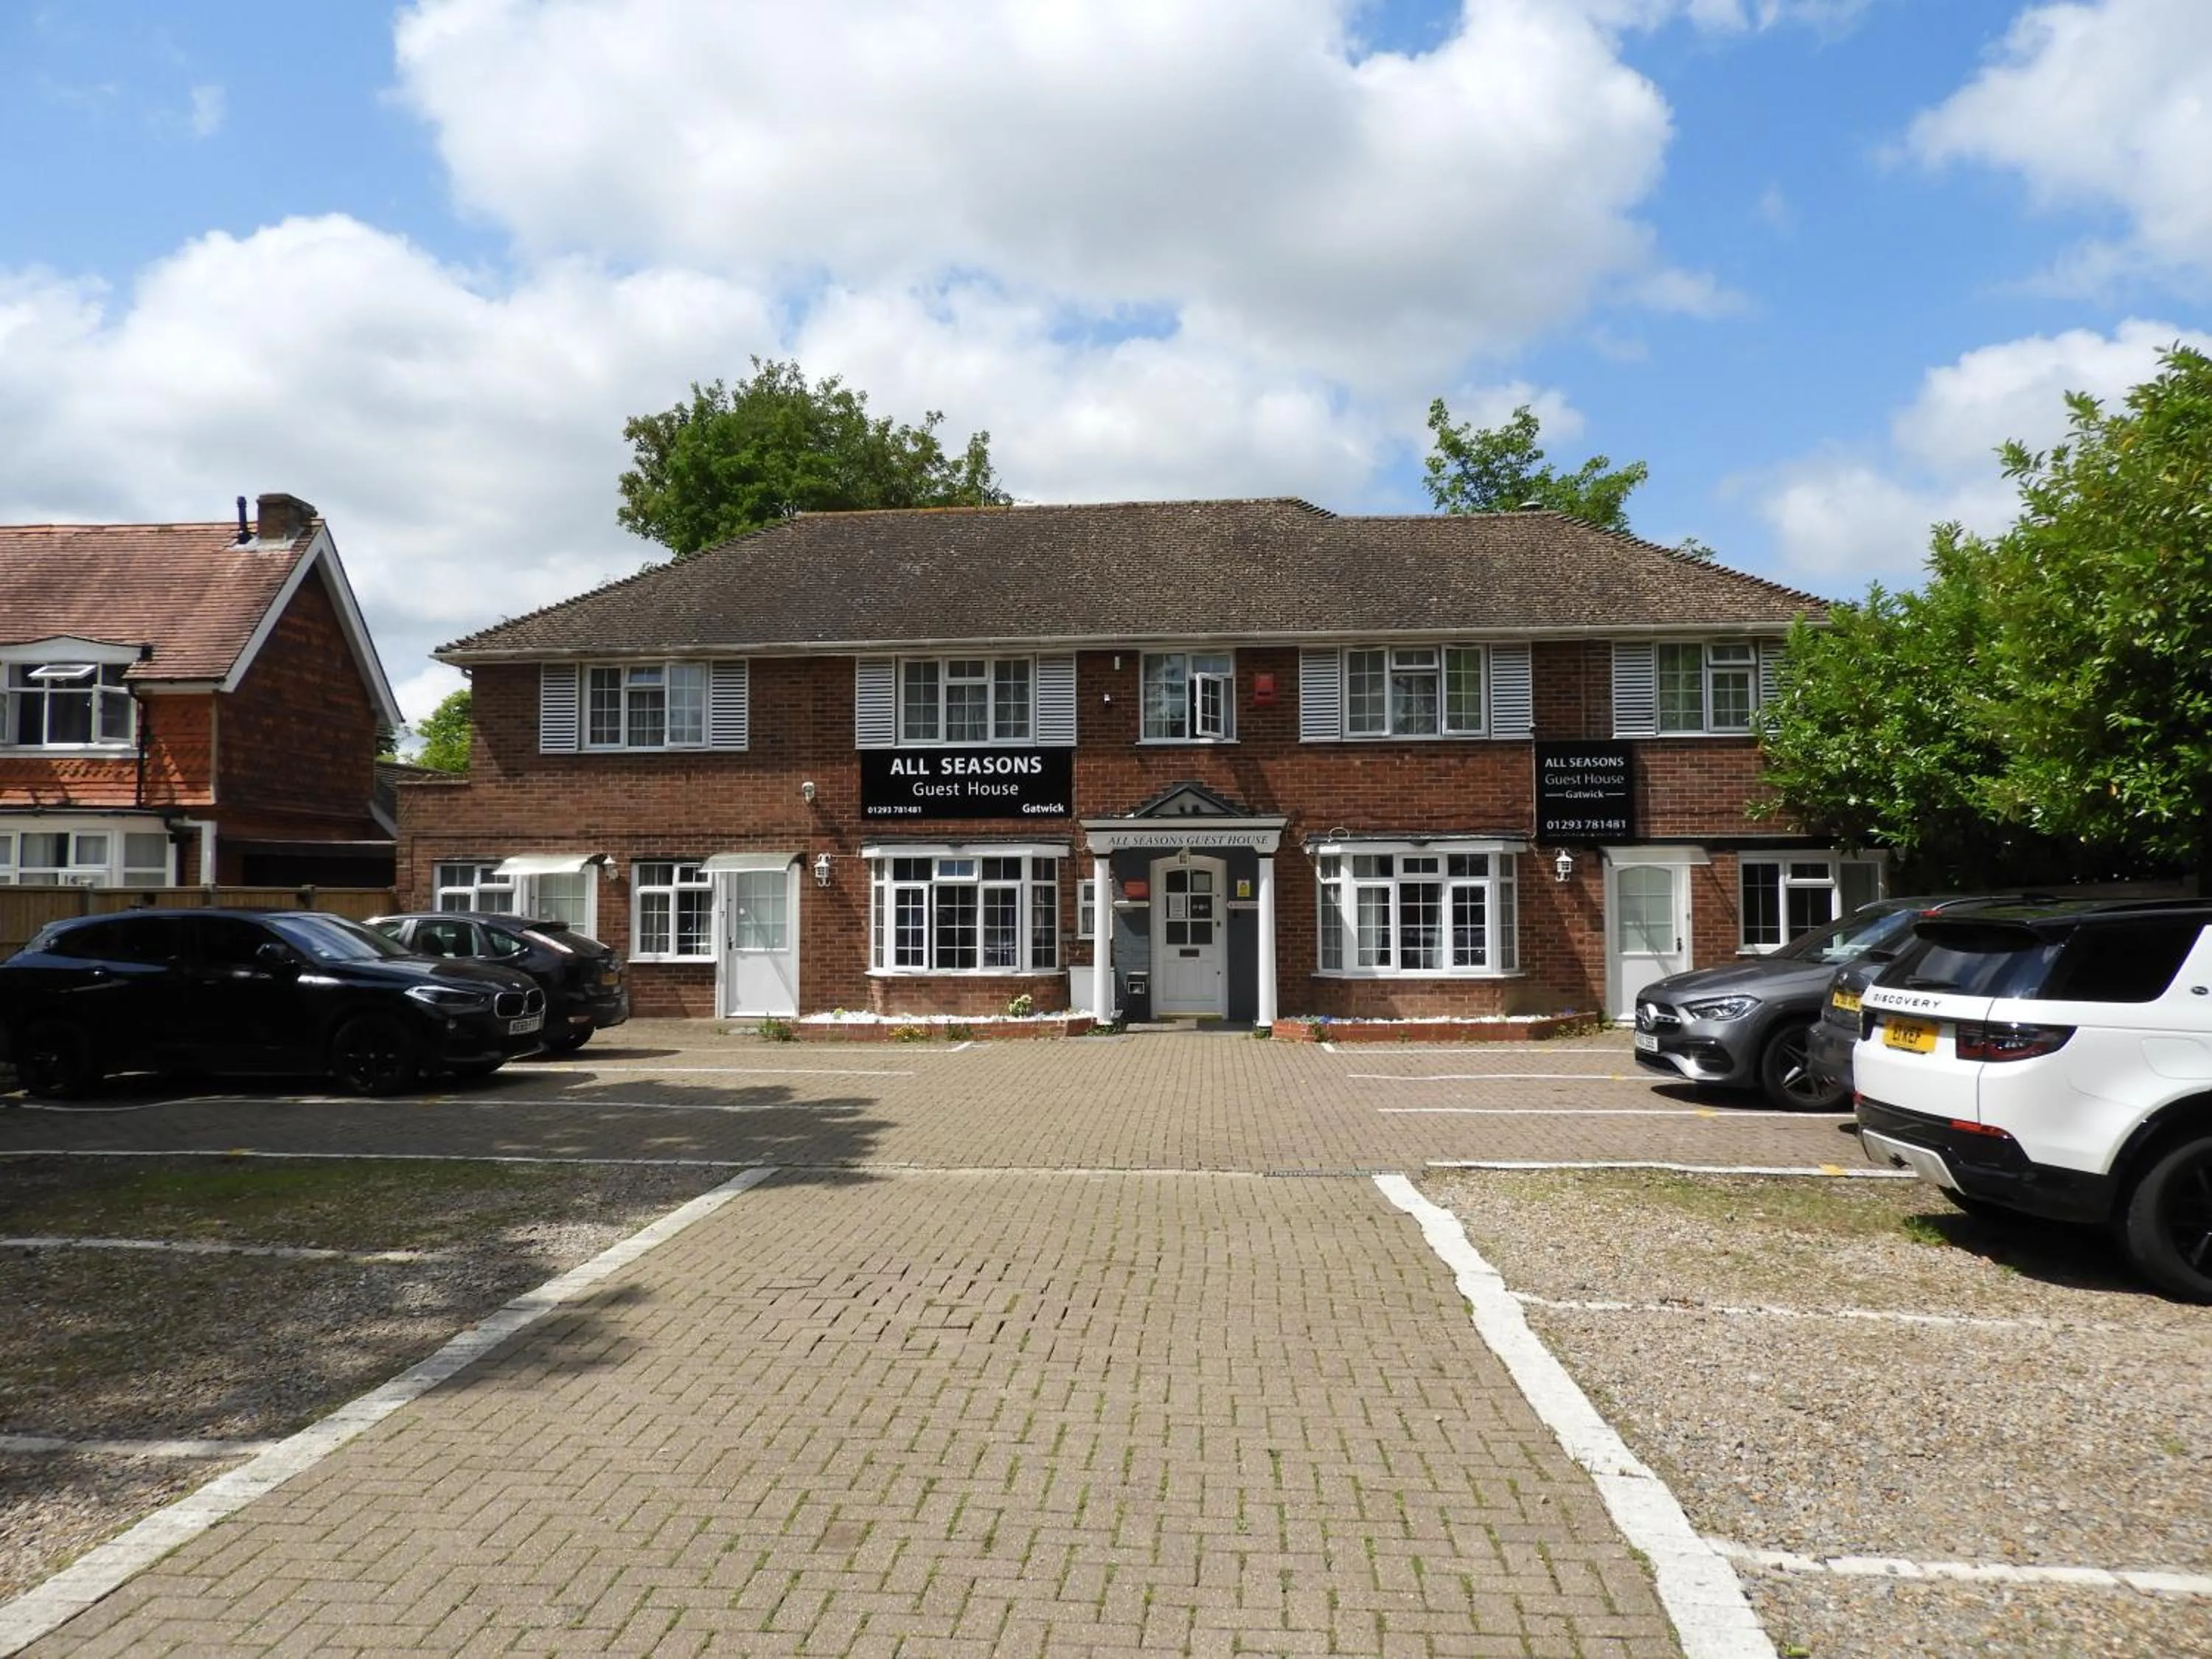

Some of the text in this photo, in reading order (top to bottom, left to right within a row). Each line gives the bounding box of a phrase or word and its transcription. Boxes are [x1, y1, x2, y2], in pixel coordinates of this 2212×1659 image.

[890, 756, 1043, 775] ALL SEASONS
[1545, 757, 1624, 768] ALL SEASONS
[1545, 773, 1624, 785] Guest House
[912, 782, 1019, 796] Guest House
[1565, 790, 1604, 799] Gatwick
[867, 806, 891, 814] 01293
[1022, 803, 1064, 813] Gatwick
[1546, 819, 1626, 830] 01293 781481
[1108, 835, 1269, 846] ALL SEASONS GUEST HOUSE
[1874, 993, 1941, 1008] DISCOVERY
